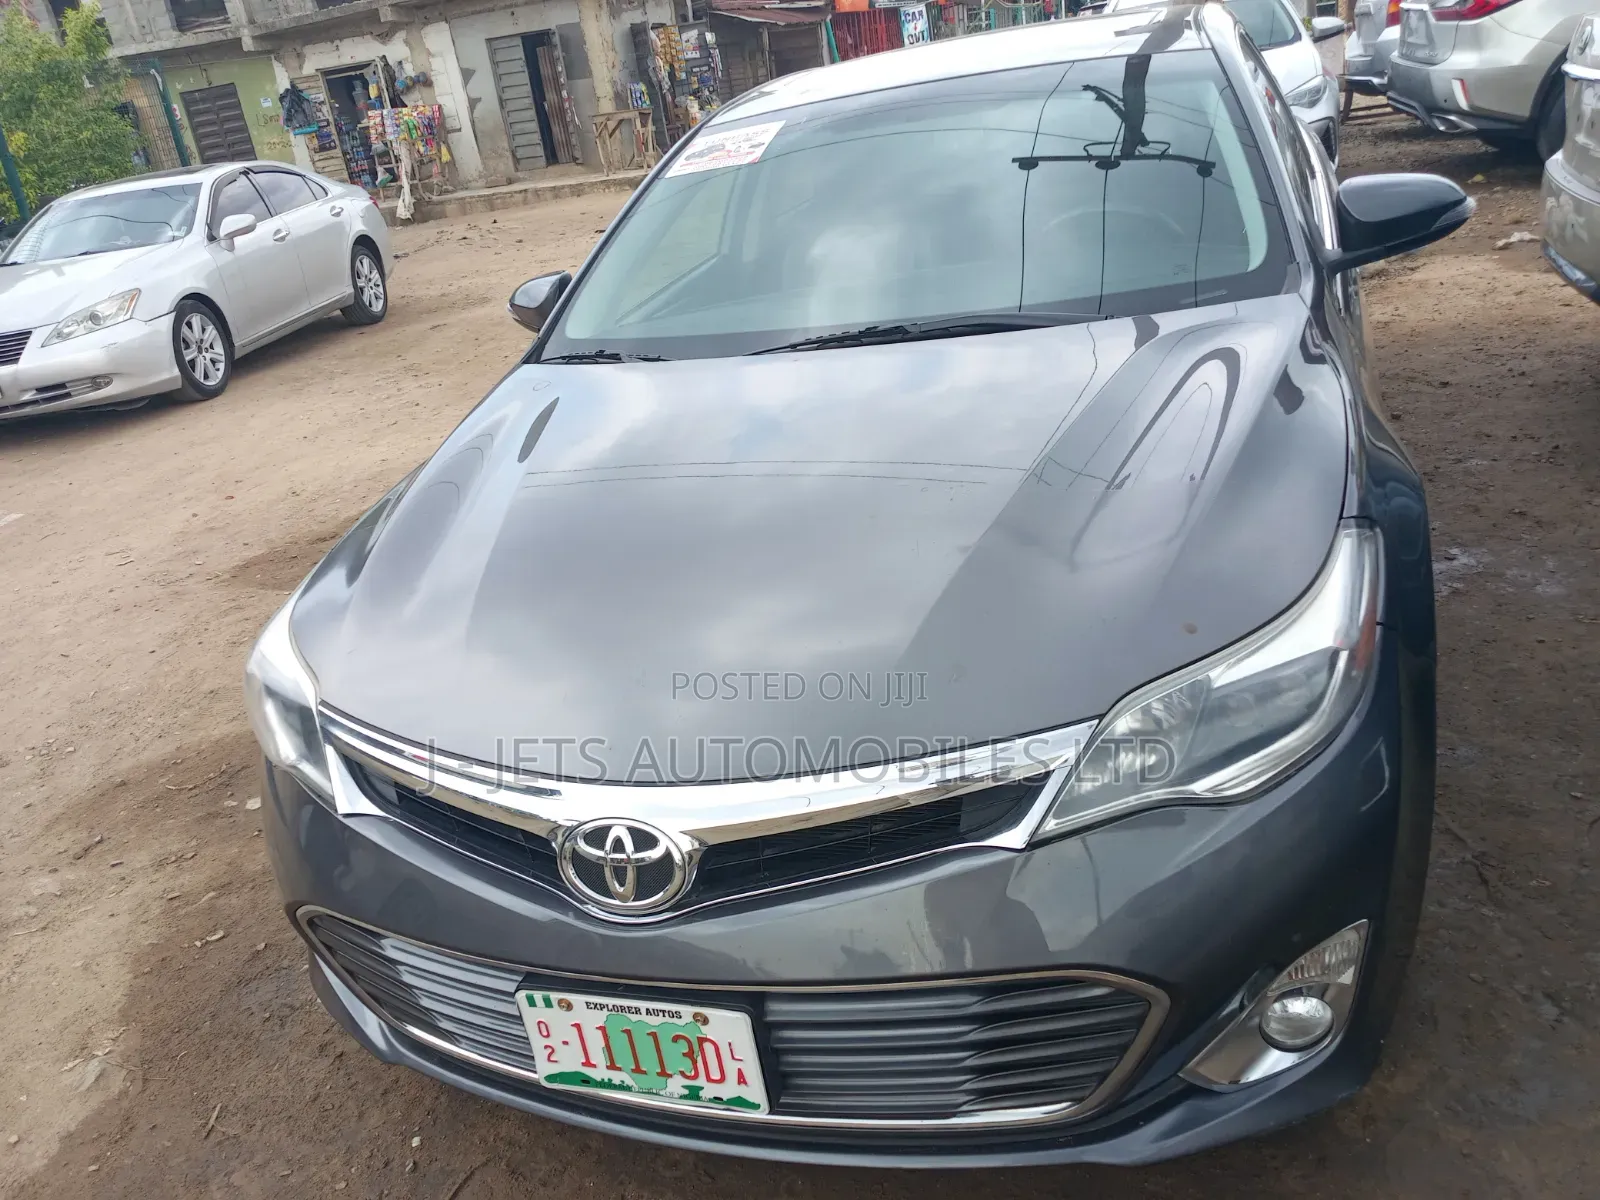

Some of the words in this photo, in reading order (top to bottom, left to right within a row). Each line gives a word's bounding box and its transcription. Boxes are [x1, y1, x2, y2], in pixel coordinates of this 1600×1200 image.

[903, 10, 924, 24] CAR
[585, 1001, 642, 1015] EXPLORER
[645, 1007, 683, 1019] AUTOS
